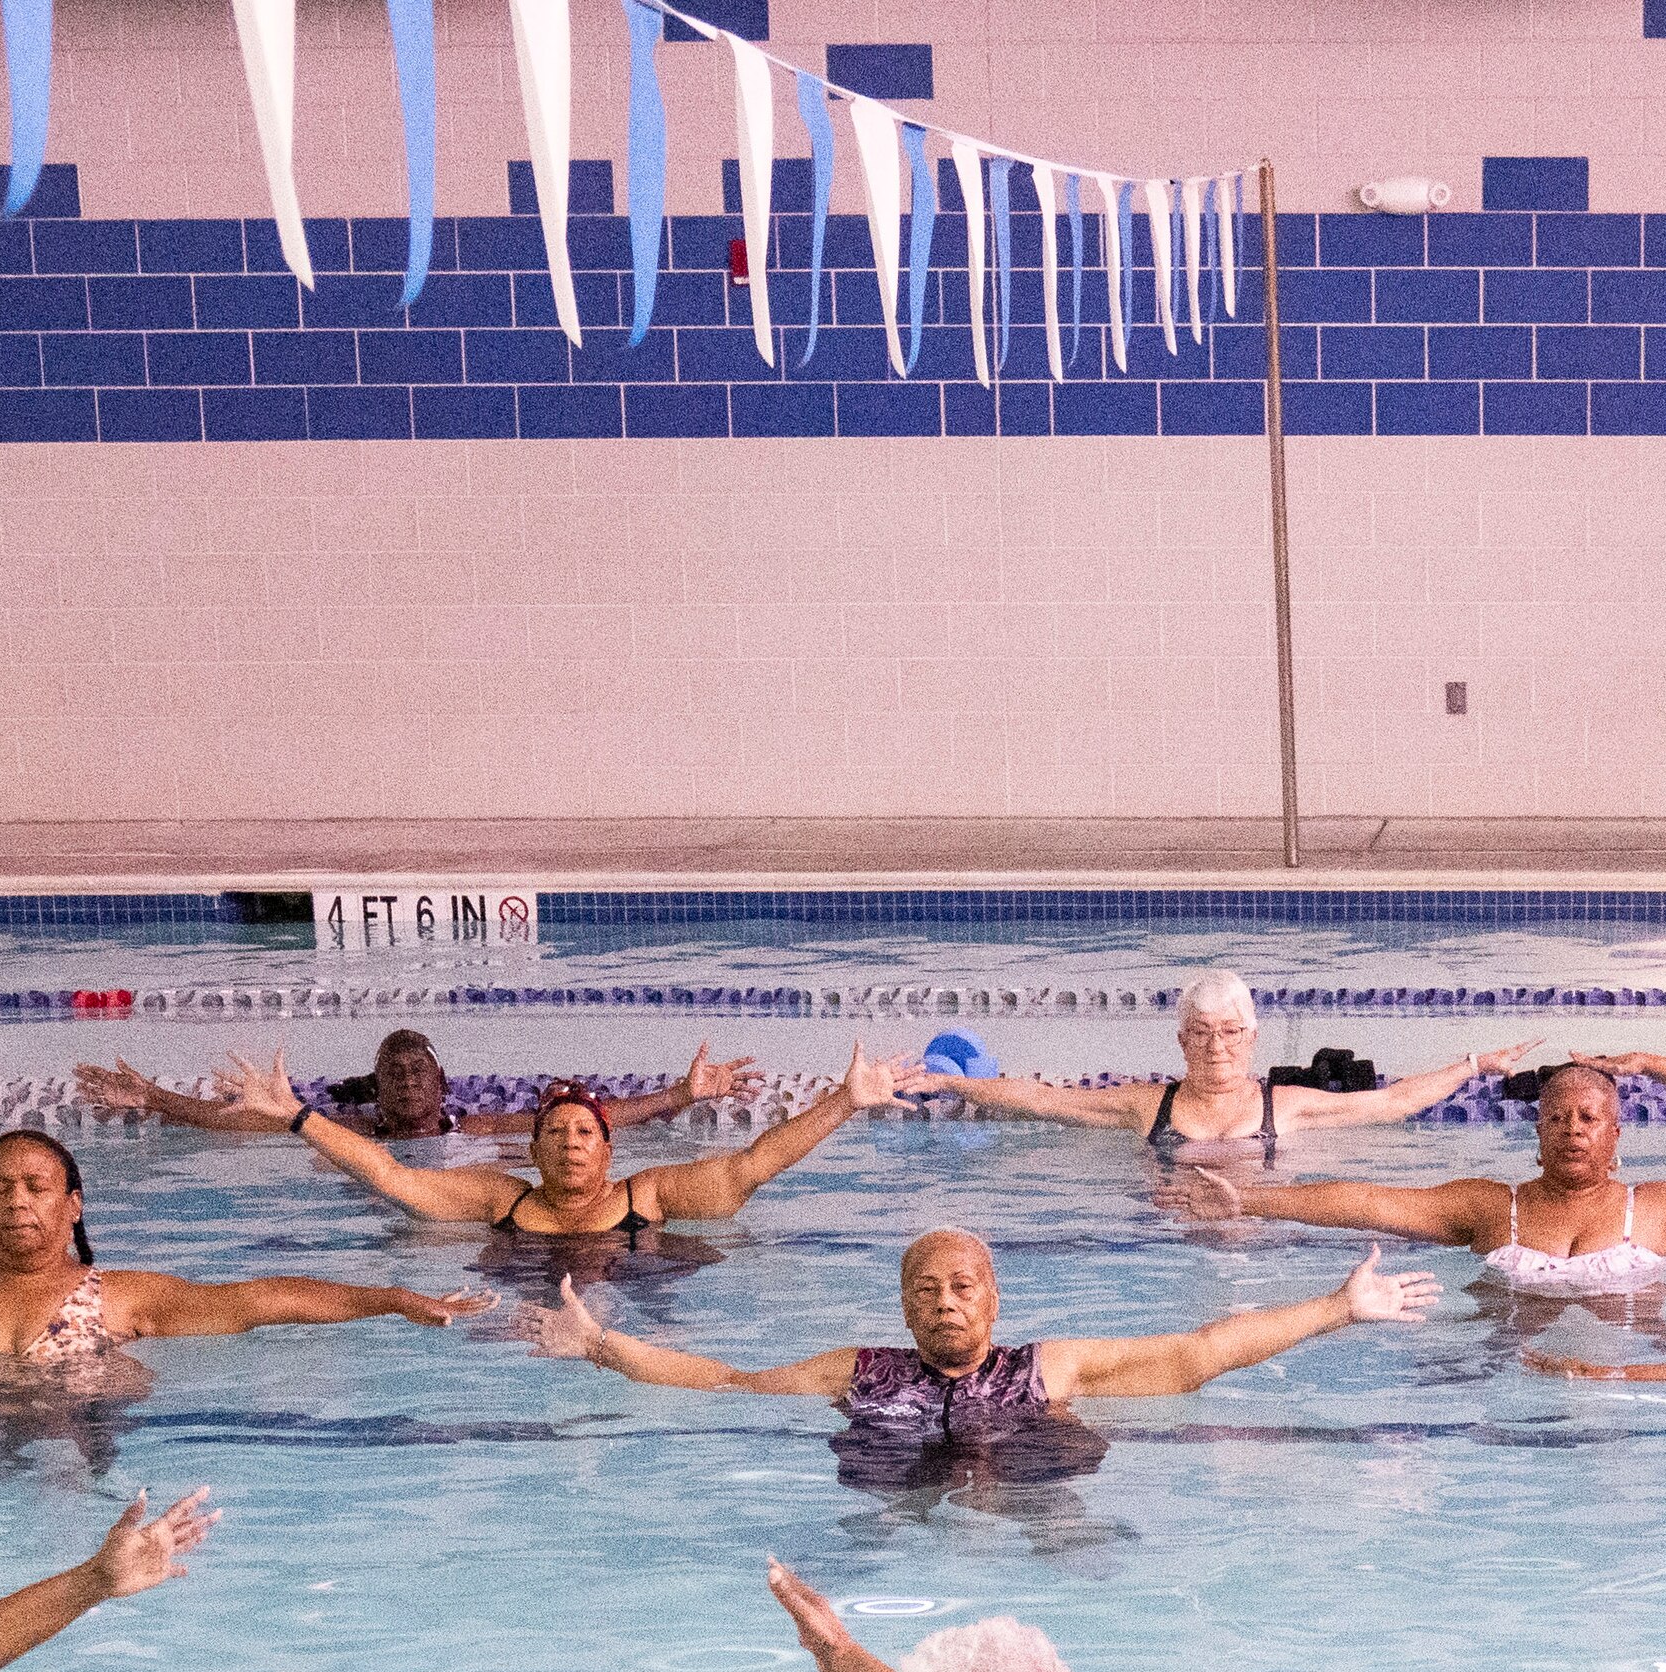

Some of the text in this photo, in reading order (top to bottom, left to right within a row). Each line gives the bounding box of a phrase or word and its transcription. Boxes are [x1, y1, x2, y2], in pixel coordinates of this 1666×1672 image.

[327, 895, 487, 946] 4 FT 6 IN
